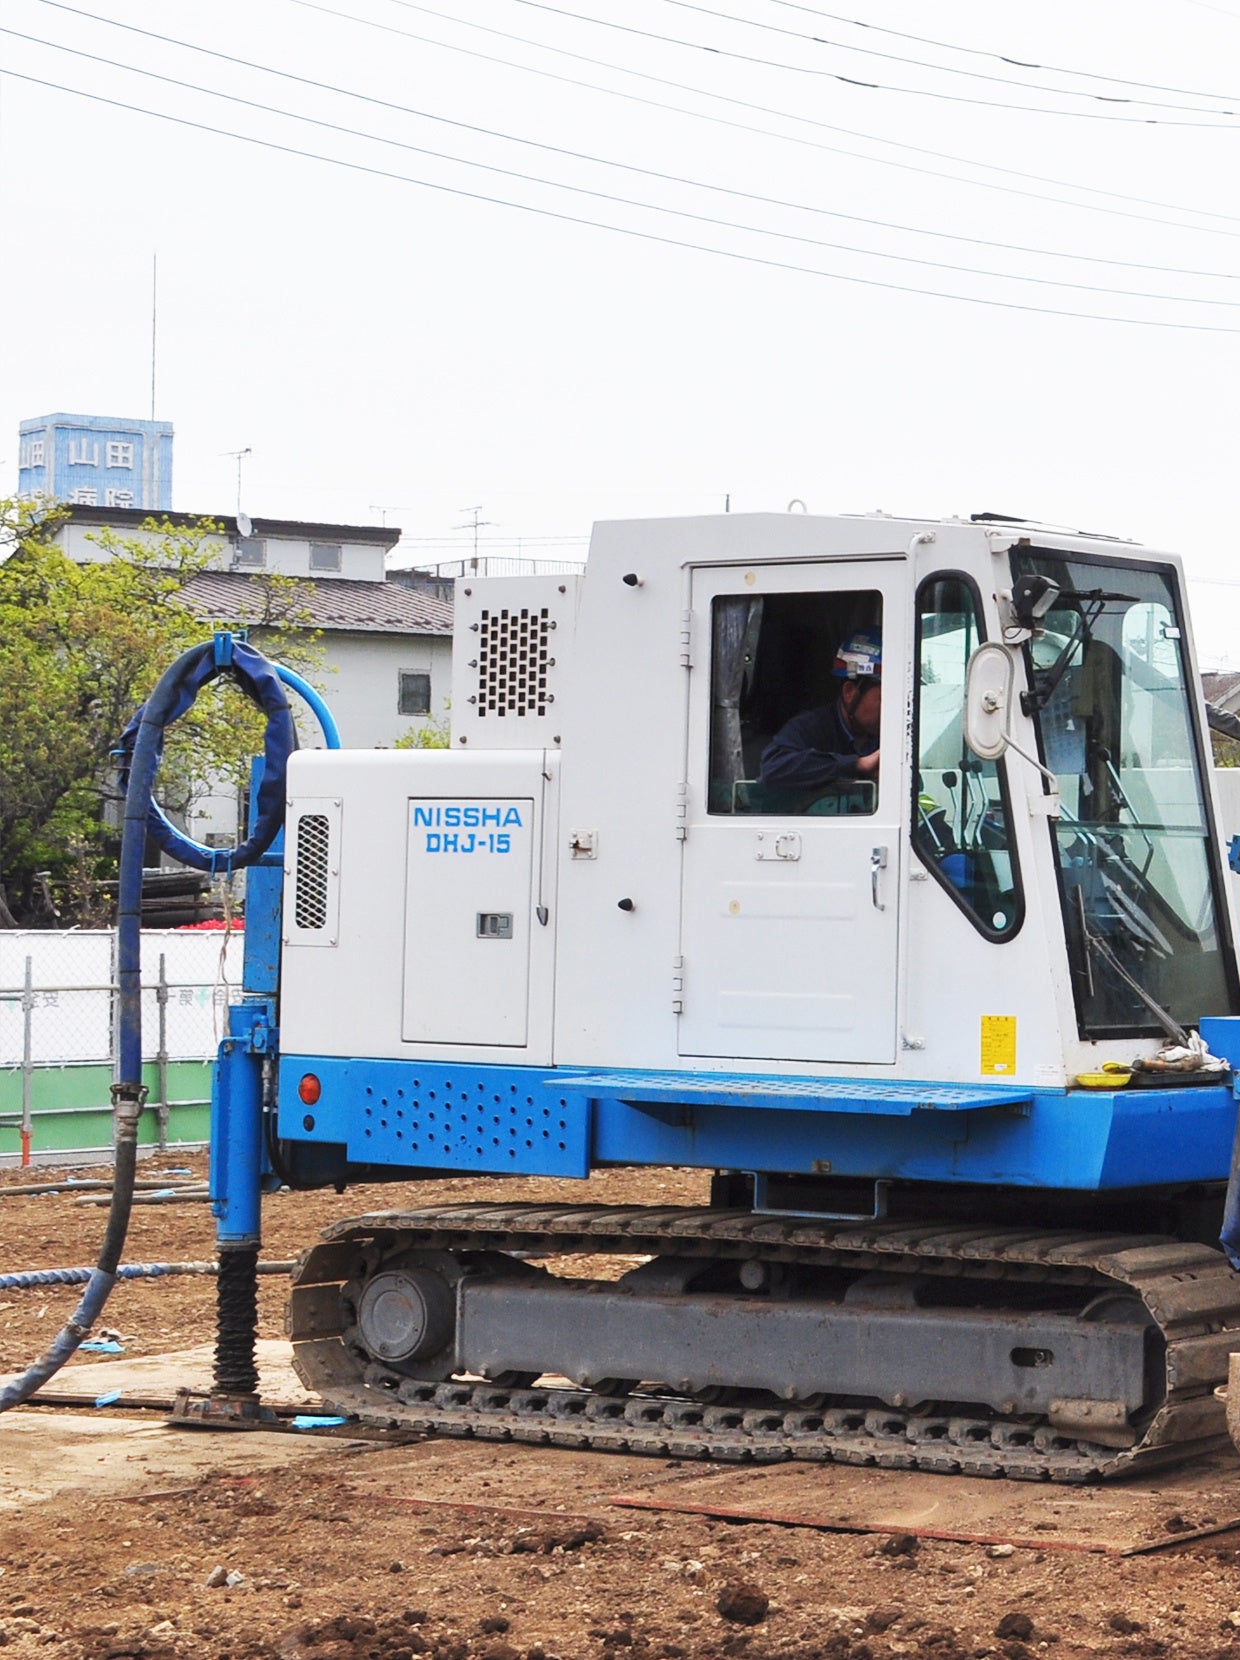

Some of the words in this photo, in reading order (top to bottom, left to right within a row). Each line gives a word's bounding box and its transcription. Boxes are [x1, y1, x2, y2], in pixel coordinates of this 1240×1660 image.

[68, 438, 134, 470] 山田
[414, 807, 523, 827] NISSHA
[426, 834, 511, 853] DHJ-15
